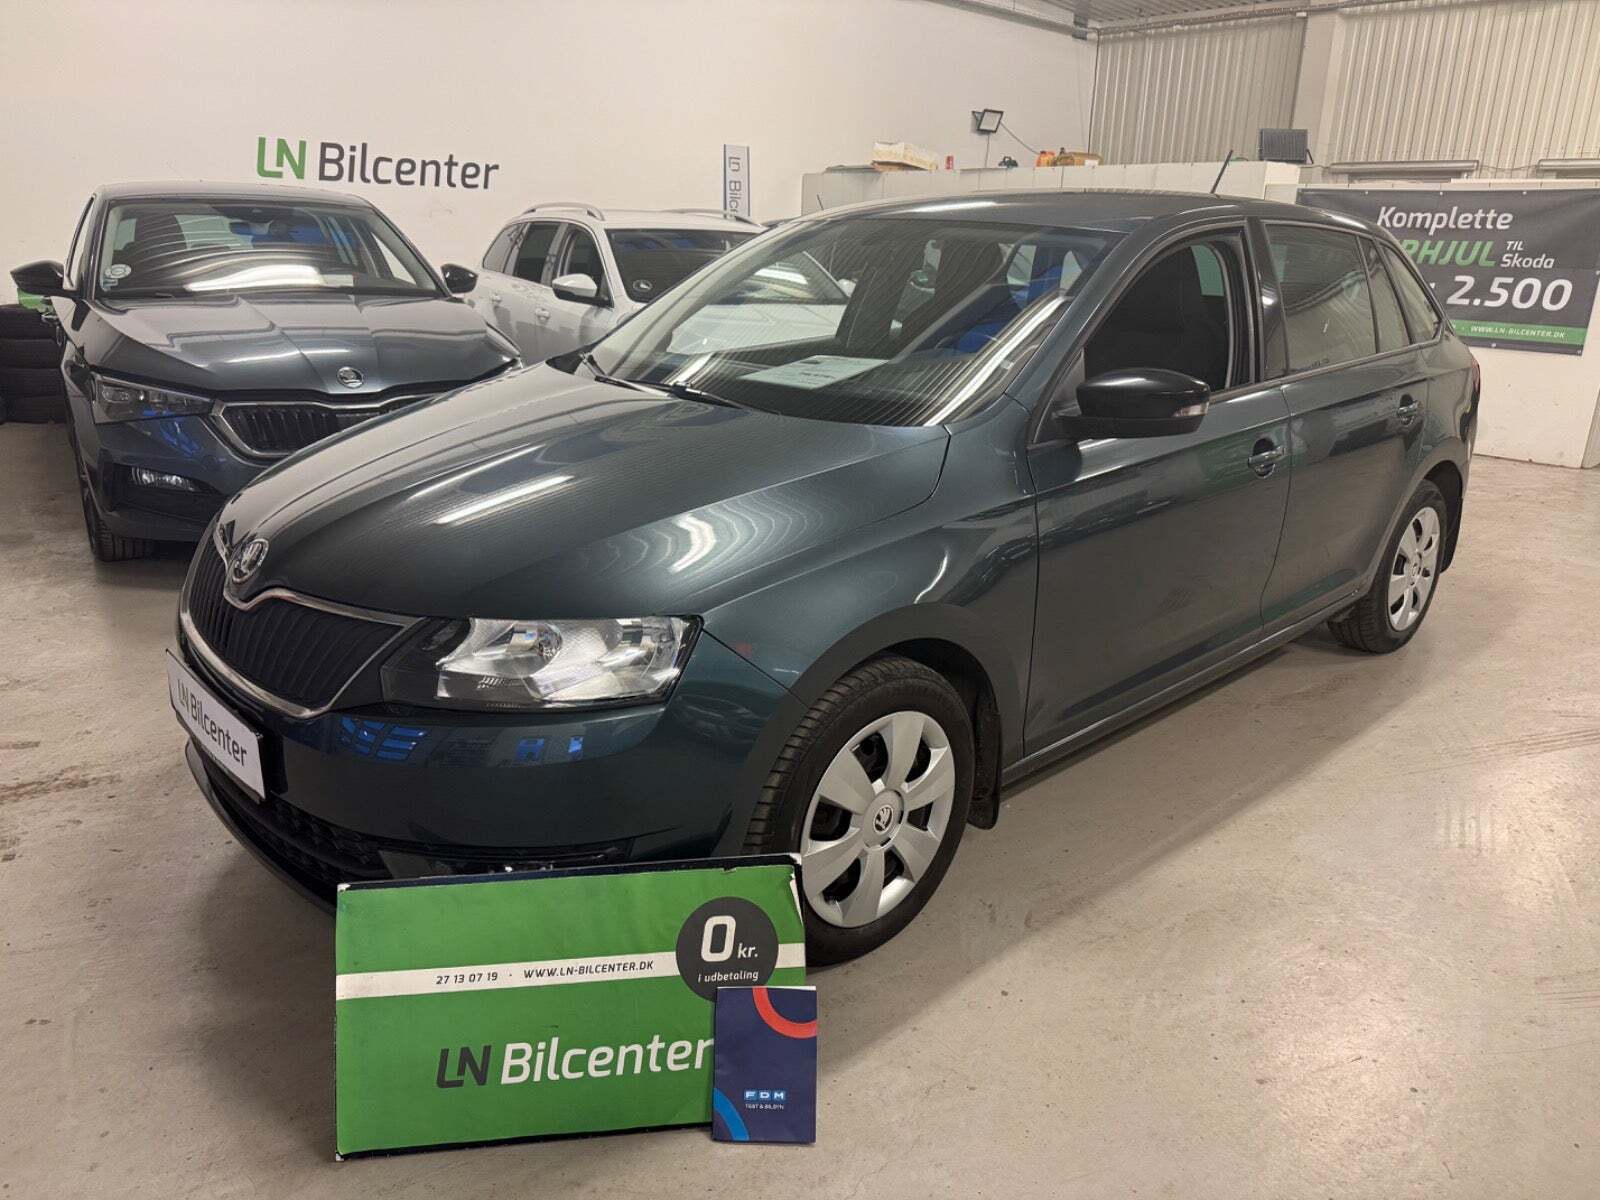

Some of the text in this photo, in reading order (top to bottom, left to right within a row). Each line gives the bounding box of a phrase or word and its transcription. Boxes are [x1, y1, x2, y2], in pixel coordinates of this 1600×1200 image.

[256, 136, 500, 189] LN Bilcenter
[1376, 205, 1513, 236] Komplette
[1500, 253, 1555, 269] Skoda
[1506, 240, 1524, 251] TIL
[1446, 275, 1573, 312] 2.500
[190, 692, 248, 767] Bilcenter
[701, 915, 758, 962] 0 kr.
[435, 960, 654, 985] 27 13 07 19 WWW.LN-BILCENTER.DK
[704, 970, 759, 982] udbetaling
[436, 1034, 715, 1089] LN Bilcenter
[745, 1091, 784, 1100] FDM
